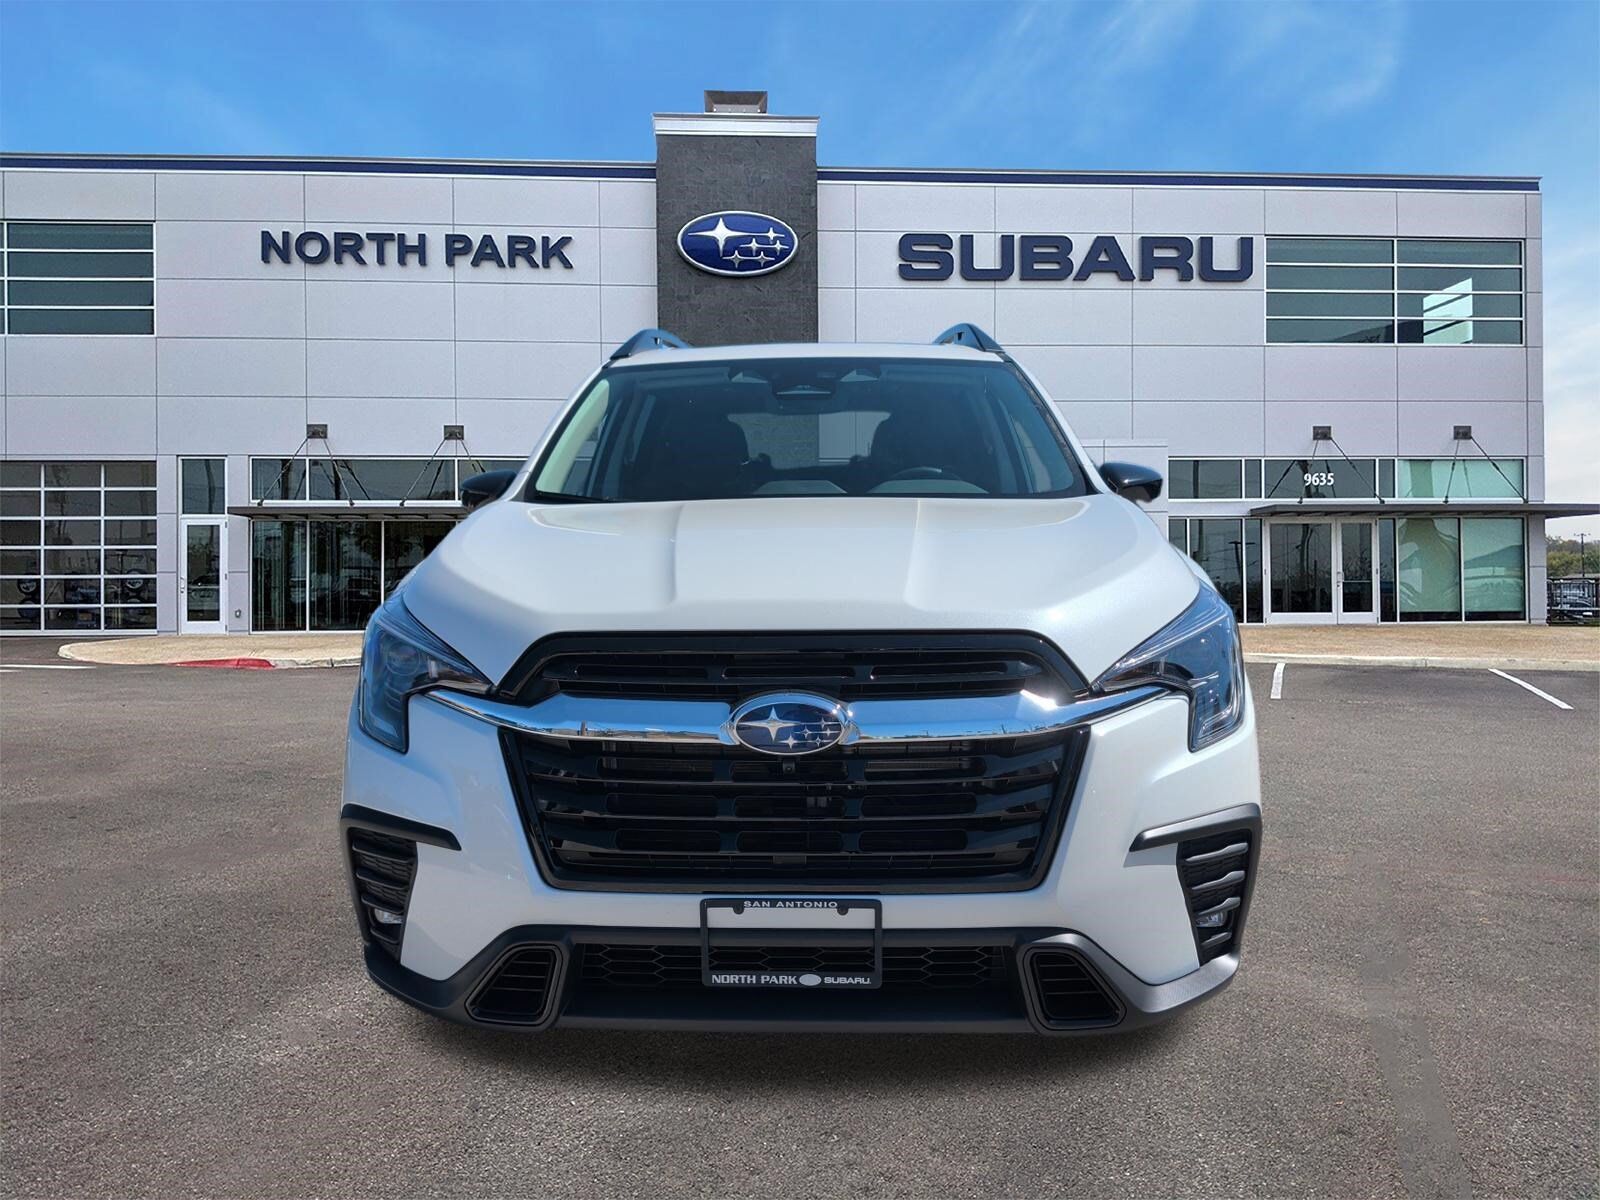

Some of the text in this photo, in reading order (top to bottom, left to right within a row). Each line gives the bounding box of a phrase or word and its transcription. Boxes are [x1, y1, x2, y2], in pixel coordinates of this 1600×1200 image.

[260, 230, 574, 269] NORTH PARK
[898, 232, 1254, 282] SUBARU
[1303, 472, 1335, 488] 9635
[743, 900, 838, 909] SAN ANTONIO
[711, 974, 871, 985] NORTH PARK SUBARU
